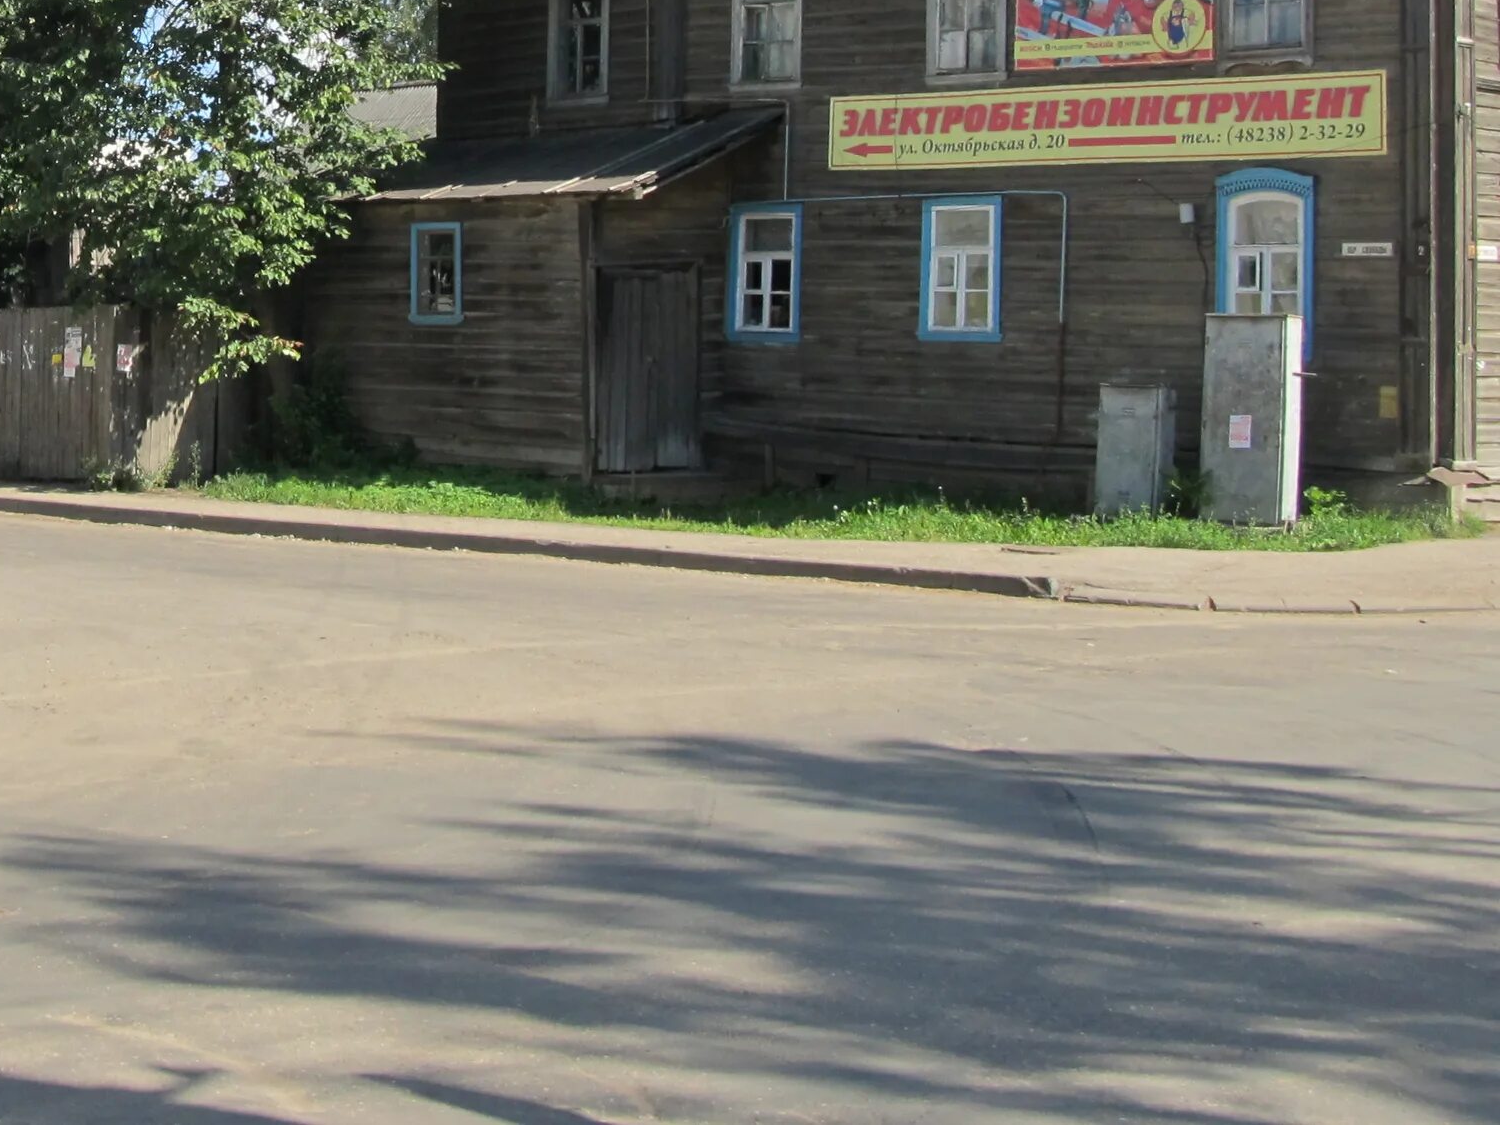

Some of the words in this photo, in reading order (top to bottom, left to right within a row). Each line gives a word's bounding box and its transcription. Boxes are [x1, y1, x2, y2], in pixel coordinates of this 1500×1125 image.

[839, 85, 1371, 137] ЭЛЕКТРОБЕНЗОИНСТРУМЕНТ
[897, 145, 918, 158] ул.
[922, 136, 1025, 157] Октябрьская
[1028, 133, 1042, 150] д.
[1046, 134, 1066, 150] 20
[1181, 132, 1222, 146] тел.:
[1226, 123, 1295, 146] (48238)
[1299, 123, 1366, 142] 2-32-29
